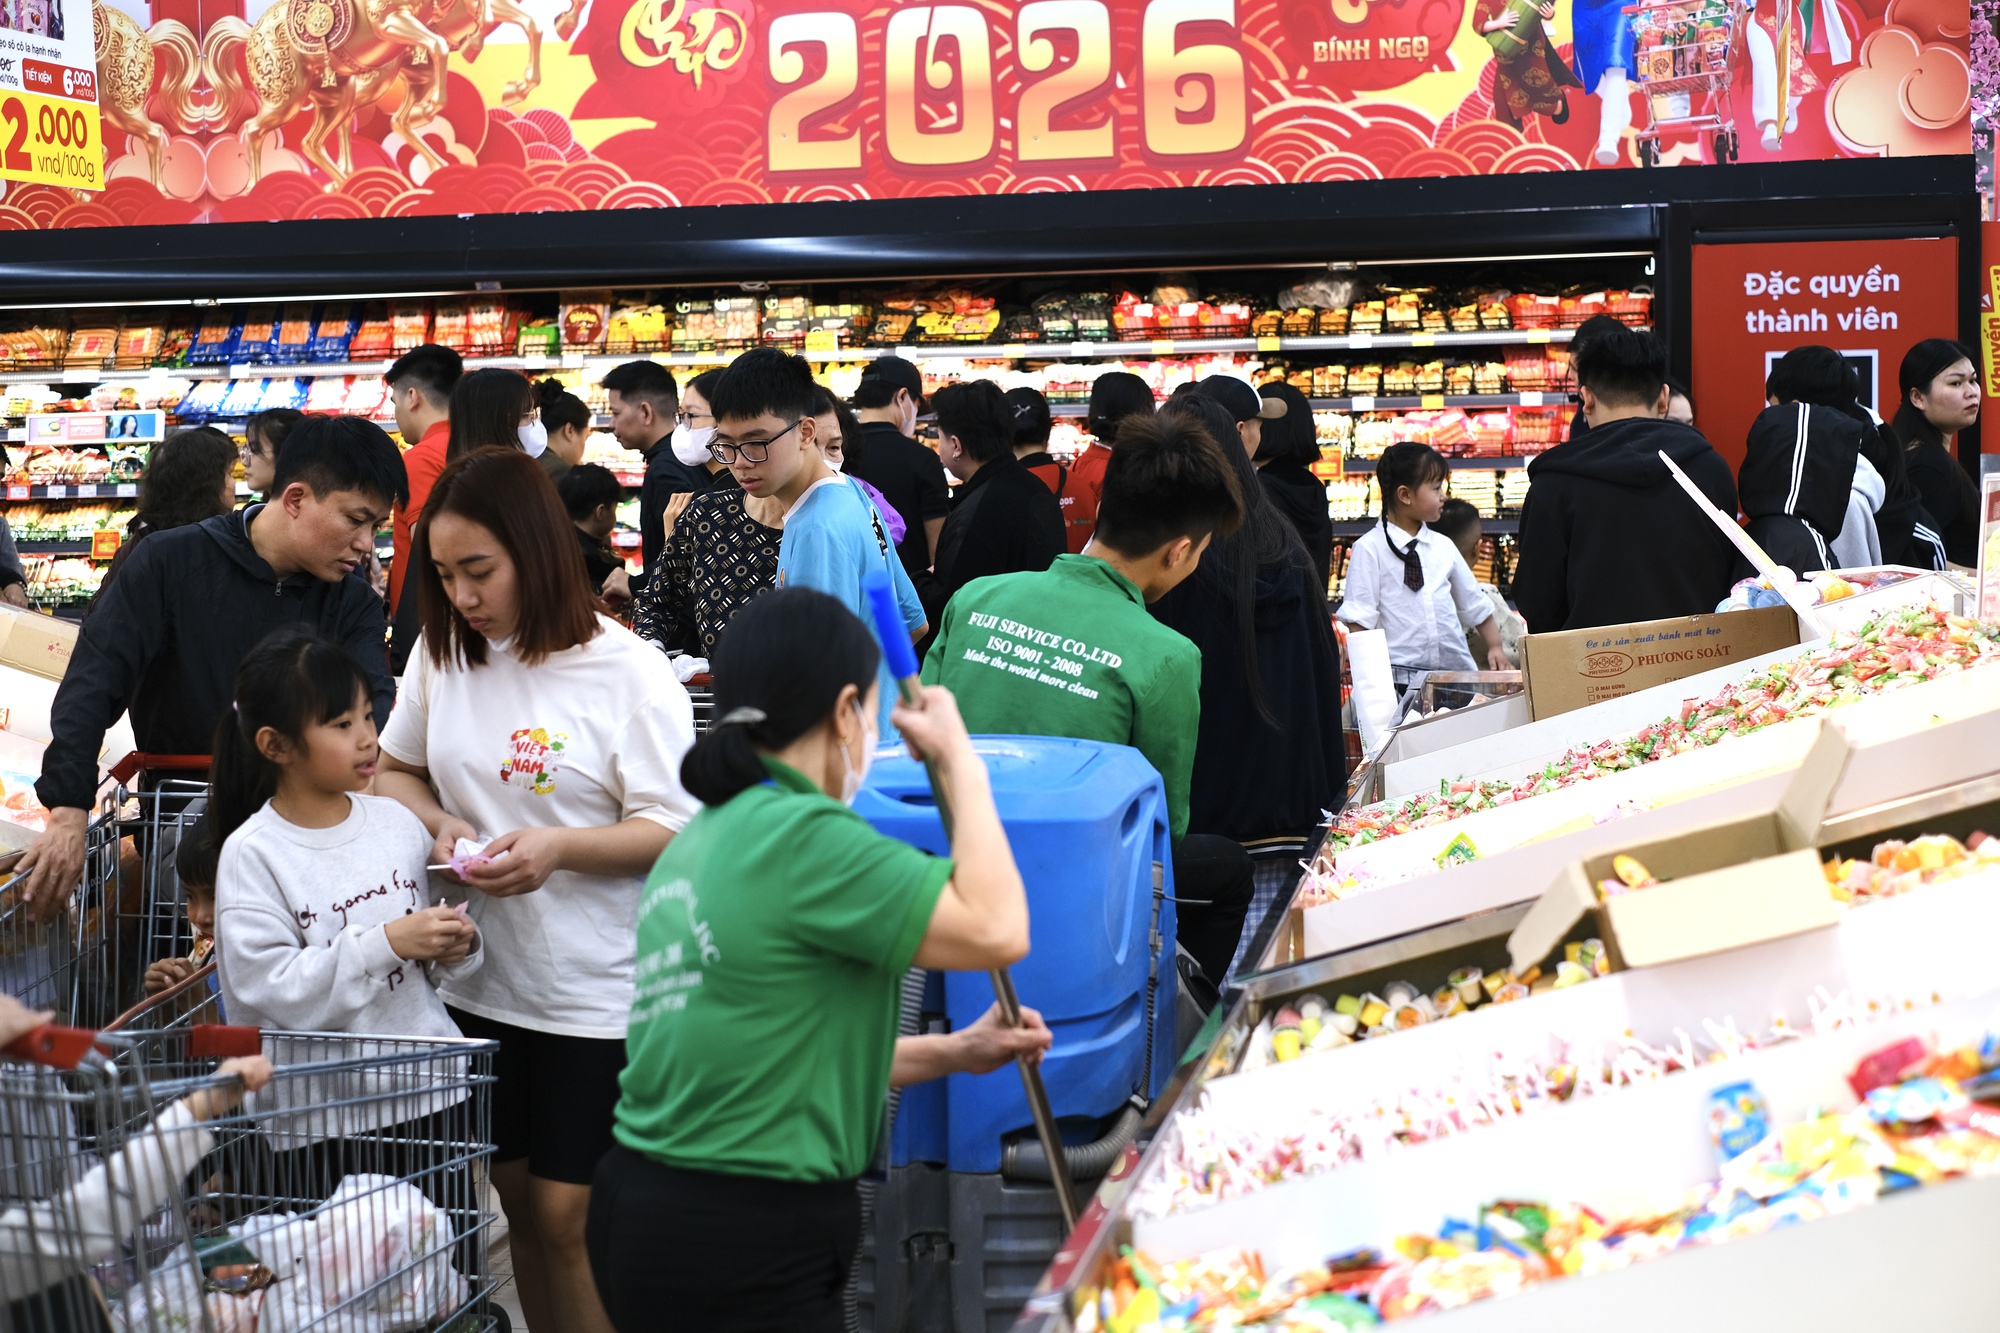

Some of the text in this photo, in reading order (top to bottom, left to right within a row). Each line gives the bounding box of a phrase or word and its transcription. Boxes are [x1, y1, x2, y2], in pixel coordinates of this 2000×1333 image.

[1313, 36, 1429, 62] BÍNH NGỌ
[63, 68, 92, 95] 6.000
[768, 0, 1246, 171] 2026
[0, 97, 88, 171] 2.000
[37, 151, 95, 183] vnd/100g
[1744, 264, 1900, 300] Đặc quyền
[1745, 306, 1898, 333] thành viên
[968, 612, 999, 629] FUJI
[998, 618, 1062, 649] SERVICE
[986, 636, 1012, 654] ISO
[1014, 644, 1043, 664] 9001
[1050, 656, 1083, 677] 2008
[1637, 644, 1731, 667] PHƯƠNG SOÁT
[963, 648, 1099, 699] Make the world more clean
[511, 758, 544, 776] NAM
